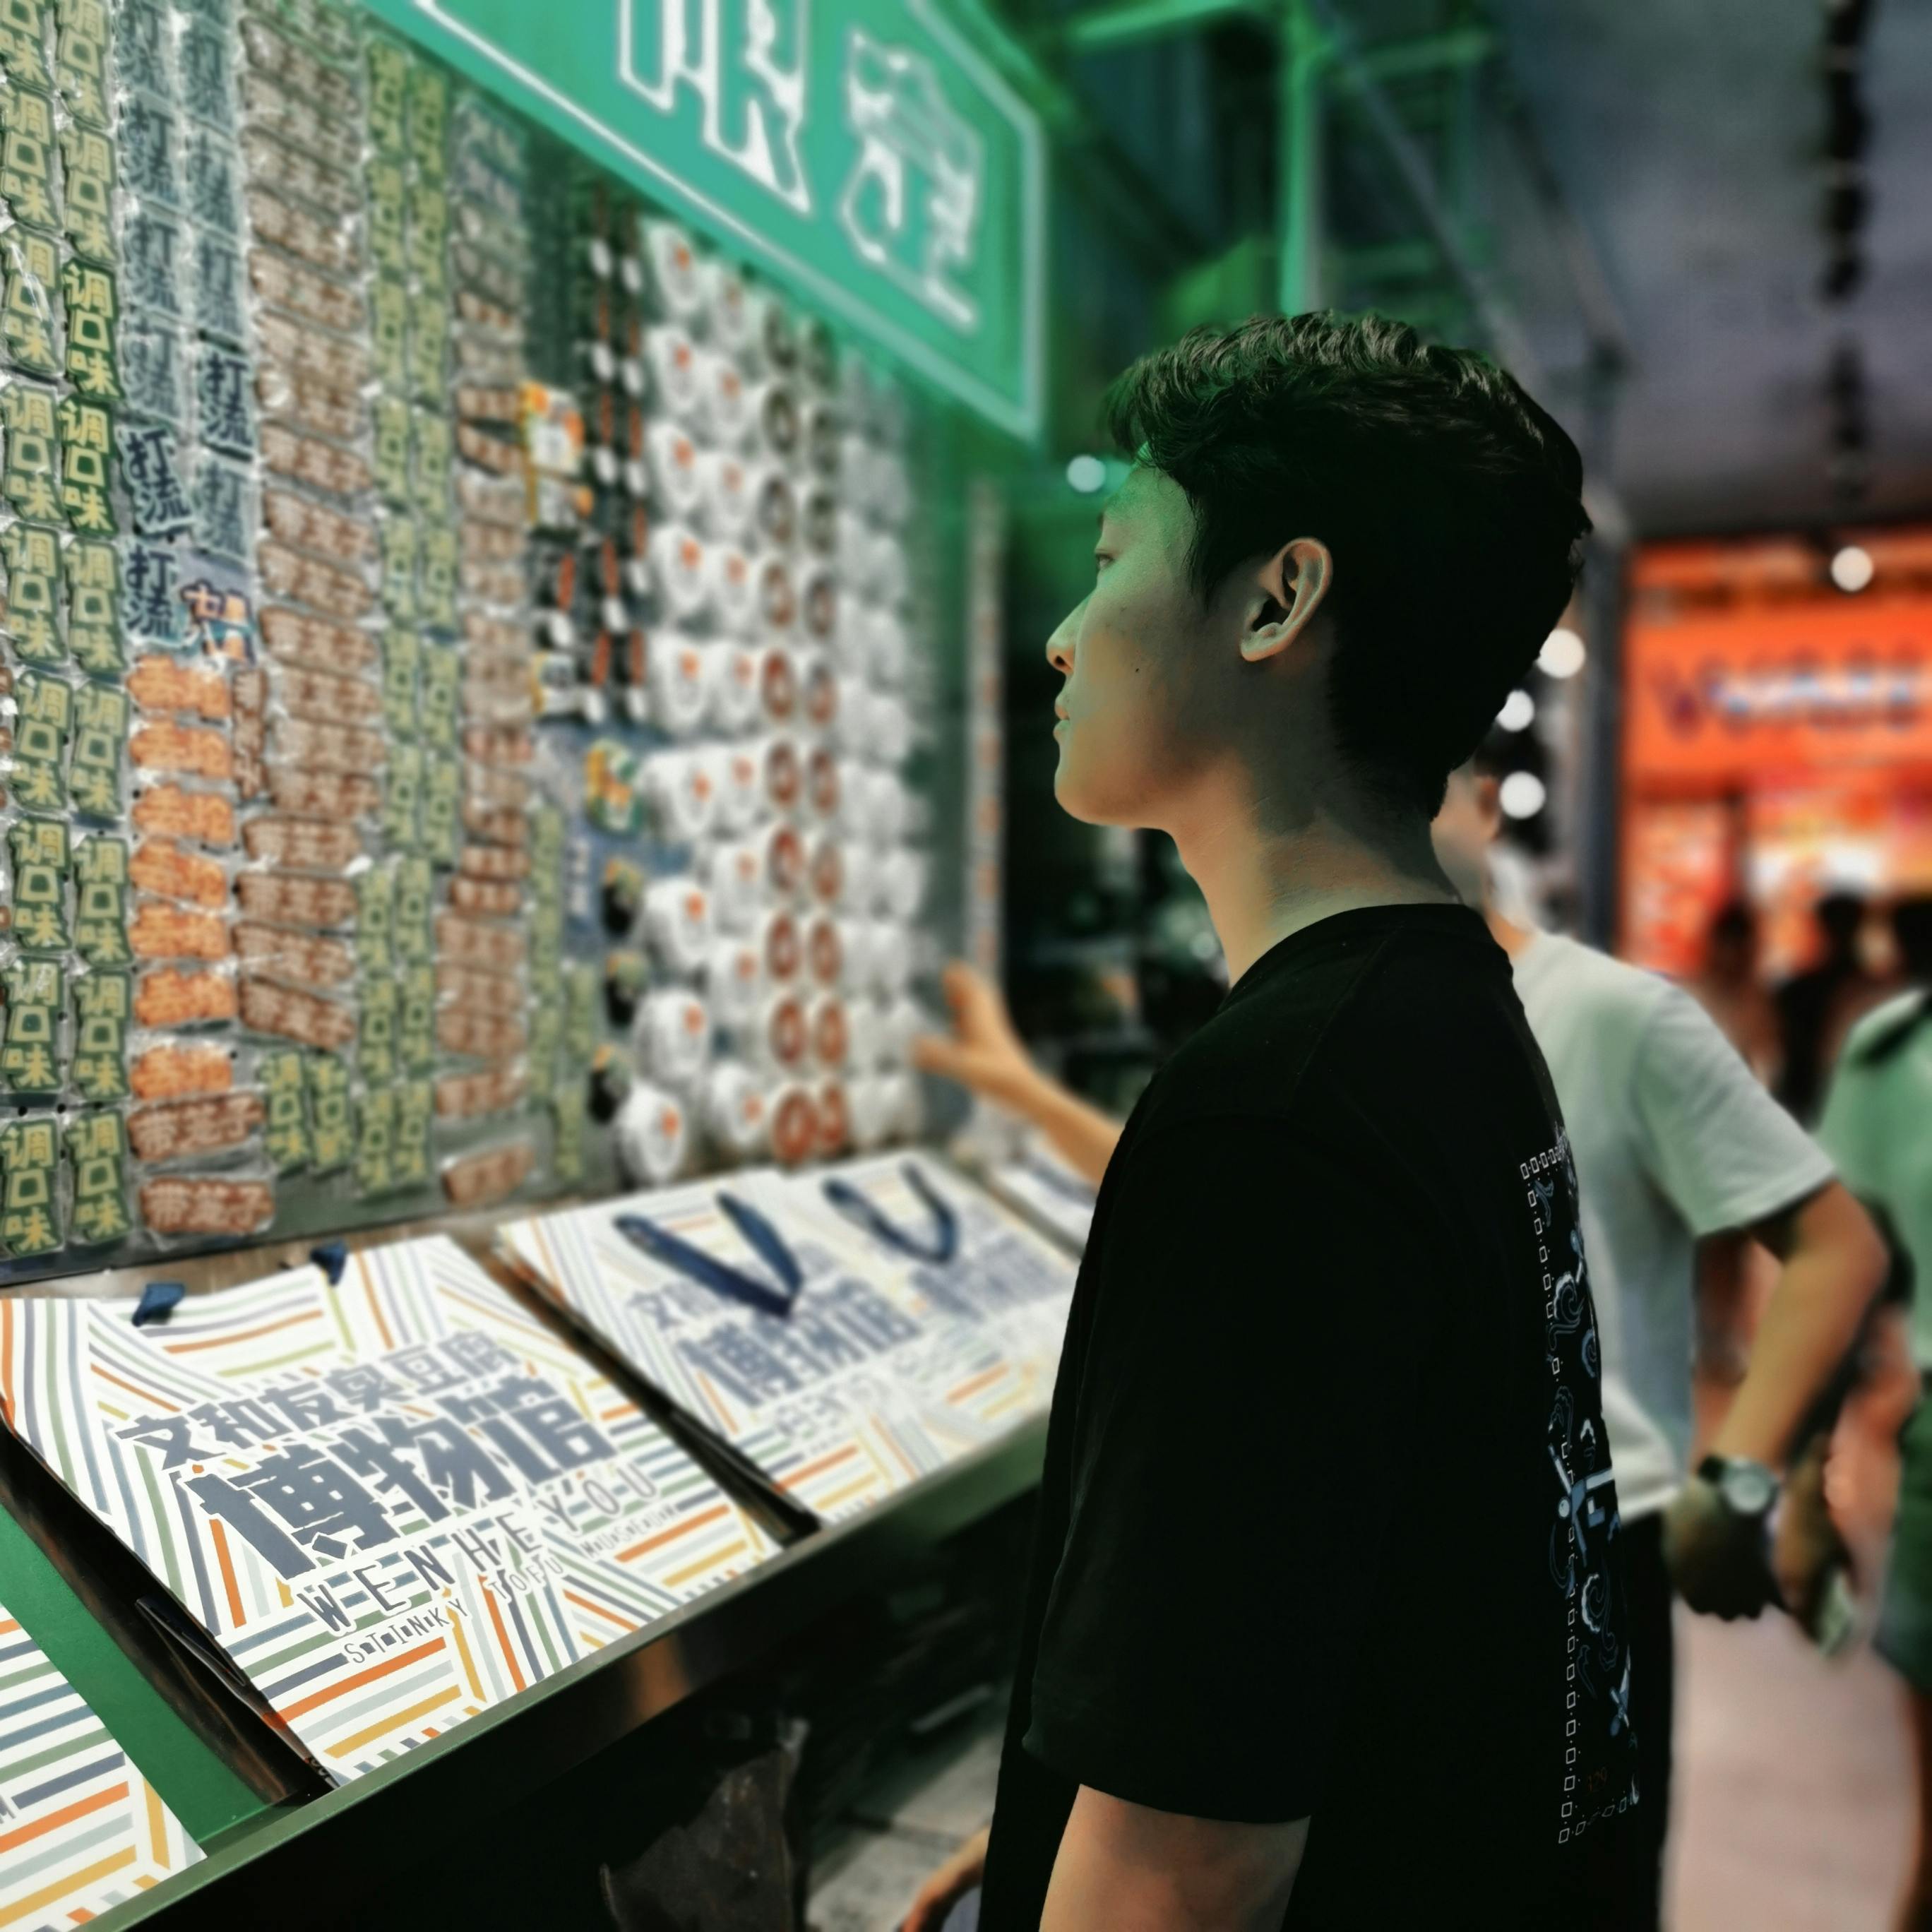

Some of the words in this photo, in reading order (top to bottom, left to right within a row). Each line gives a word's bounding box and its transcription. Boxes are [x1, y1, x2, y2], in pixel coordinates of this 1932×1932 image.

[0, 0, 47, 83] 口味
[1, 93, 56, 227] 调口味
[67, 131, 115, 264] 调口味
[6, 232, 62, 371] 调口味
[66, 267, 119, 397] 调口味
[6, 388, 62, 521] 调口味
[58, 404, 114, 534] 调口味
[127, 429, 191, 523] 打流
[4, 527, 61, 658] 调口味
[71, 545, 121, 671] 调口味
[126, 544, 175, 637] 打流
[16, 674, 69, 809] 调口味
[69, 686, 126, 814] 调口味
[11, 819, 69, 948] 调口味
[73, 840, 129, 964] 调口味
[3, 956, 62, 1089] 调口味
[74, 976, 129, 1100] 调口味
[3, 1120, 62, 1254] 调口味
[71, 1113, 127, 1239] 调口味
[114, 1330, 521, 1470] 文和友臭豆腐
[184, 1376, 617, 1580] 博物馆
[296, 1462, 657, 1633] WENHEYOU
[344, 1597, 468, 1664] STINKY
[489, 1557, 564, 1600] TOFU
